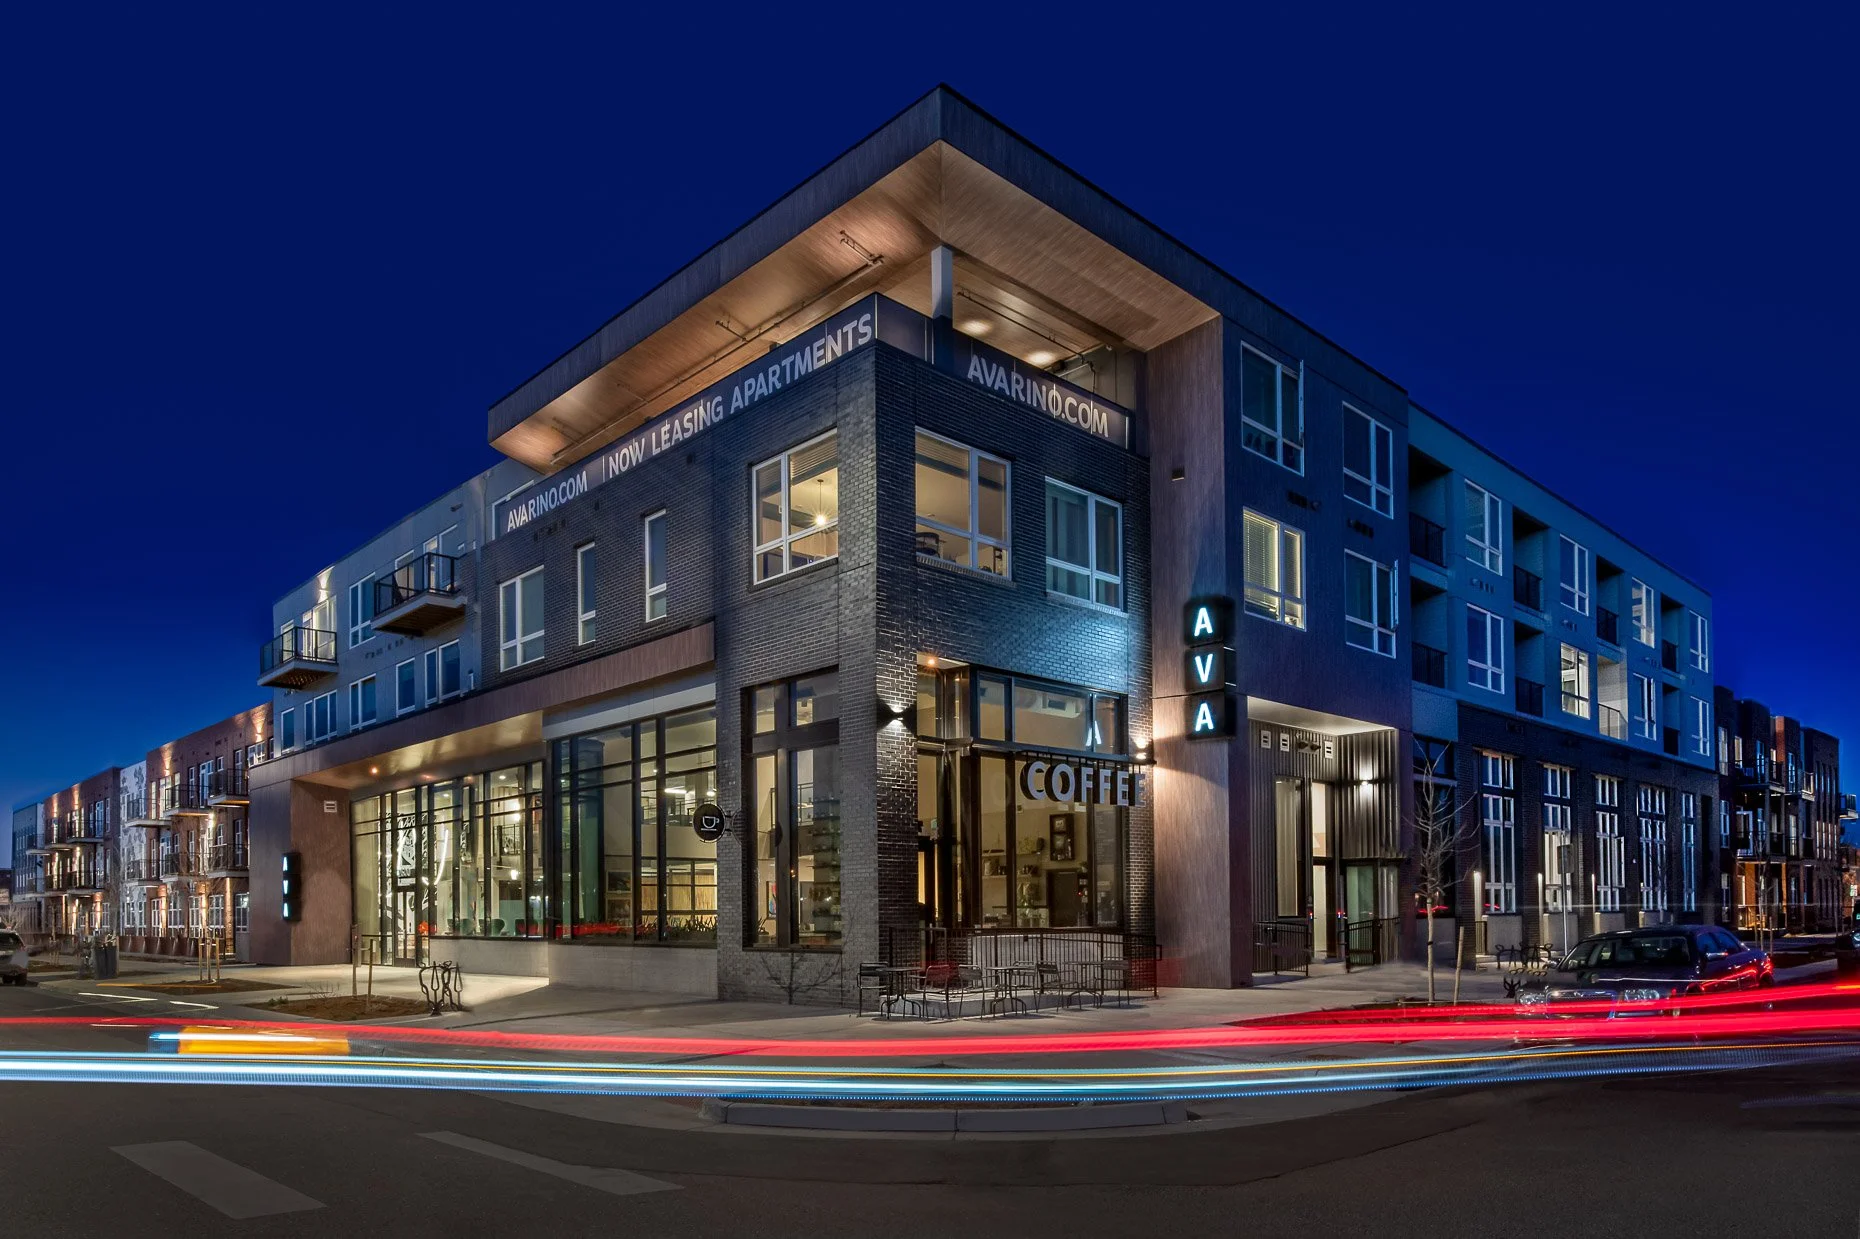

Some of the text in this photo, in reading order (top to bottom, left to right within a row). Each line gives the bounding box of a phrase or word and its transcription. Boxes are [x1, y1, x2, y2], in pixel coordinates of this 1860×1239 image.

[507, 313, 872, 533] AVARINO.COM NOW LEASING APARTMENTS
[967, 355, 1109, 438] AVARINO.COM
[1194, 607, 1214, 732] AVA
[1027, 761, 1146, 807] COFFEE
